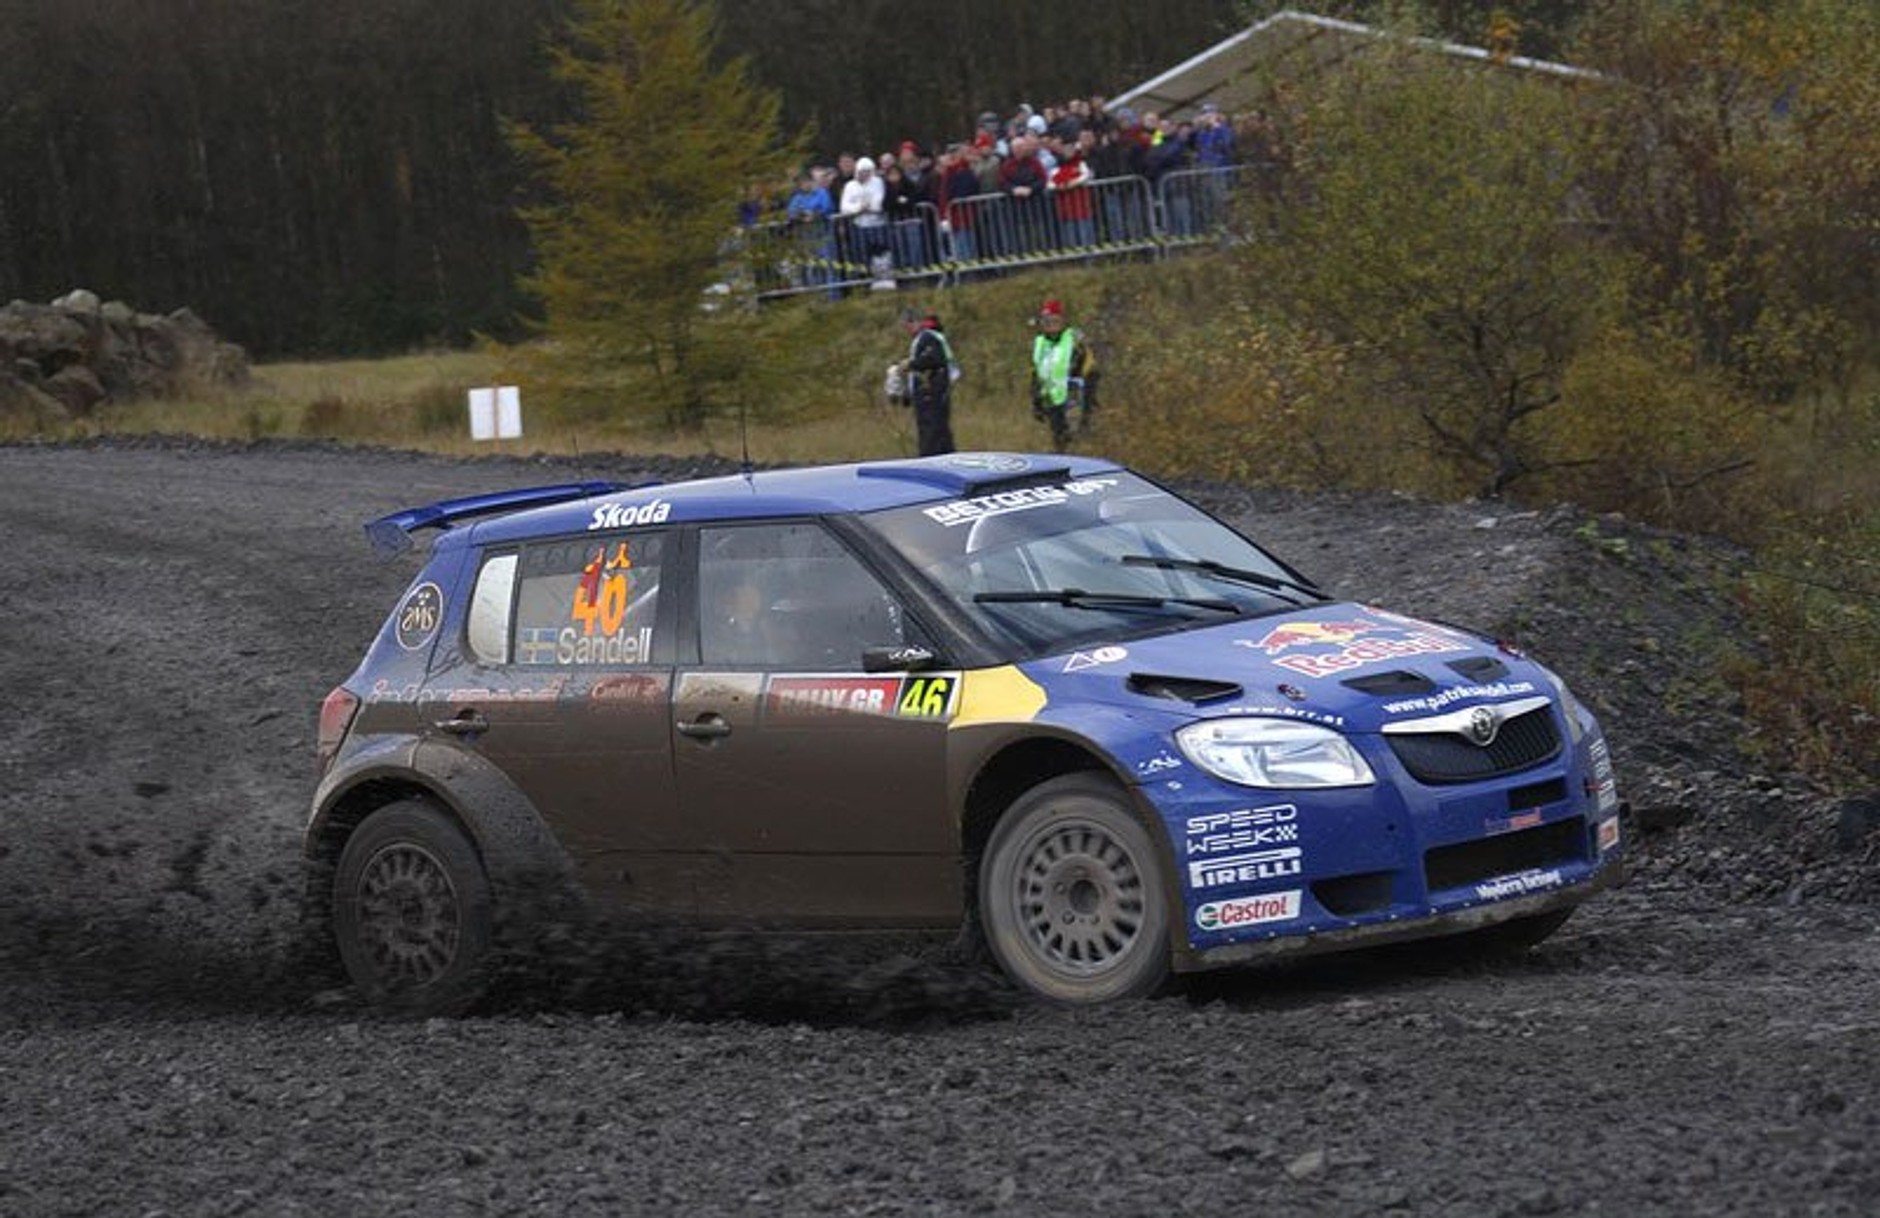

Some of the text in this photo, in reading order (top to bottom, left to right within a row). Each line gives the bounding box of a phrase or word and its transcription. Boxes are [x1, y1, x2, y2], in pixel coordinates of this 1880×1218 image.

[588, 499, 671, 530] Skoda
[557, 626, 652, 665] Sandell
[900, 678, 948, 717] 46
[1186, 803, 1297, 834] SPEED
[1186, 828, 1275, 855] WEEK
[1188, 846, 1303, 888] PIRELLI
[1220, 896, 1287, 924] Castrol
